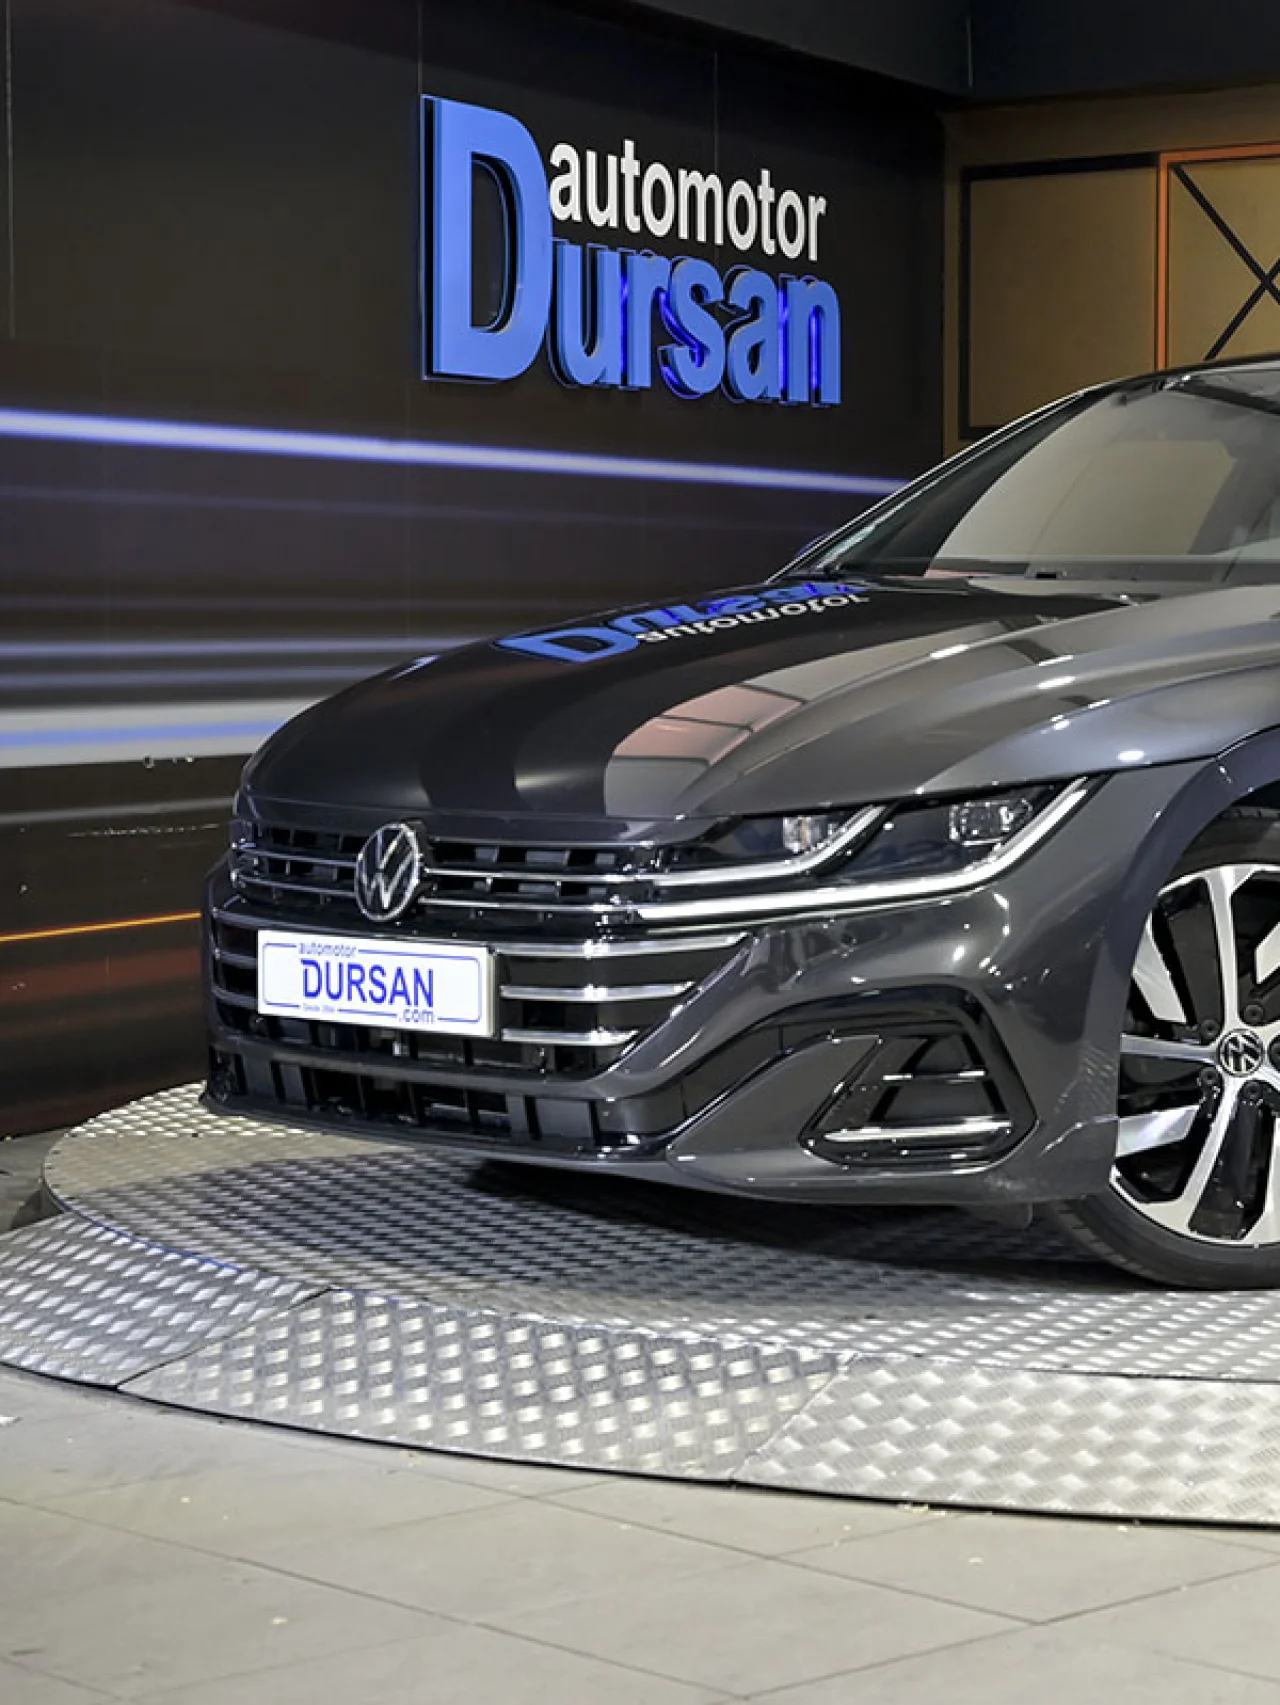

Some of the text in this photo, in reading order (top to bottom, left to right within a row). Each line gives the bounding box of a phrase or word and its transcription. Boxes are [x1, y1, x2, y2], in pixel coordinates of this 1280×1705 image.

[549, 138, 827, 262] automotor
[421, 93, 843, 408] Dursan
[300, 957, 434, 1008] DURSAN
[399, 1008, 435, 1024] .com
